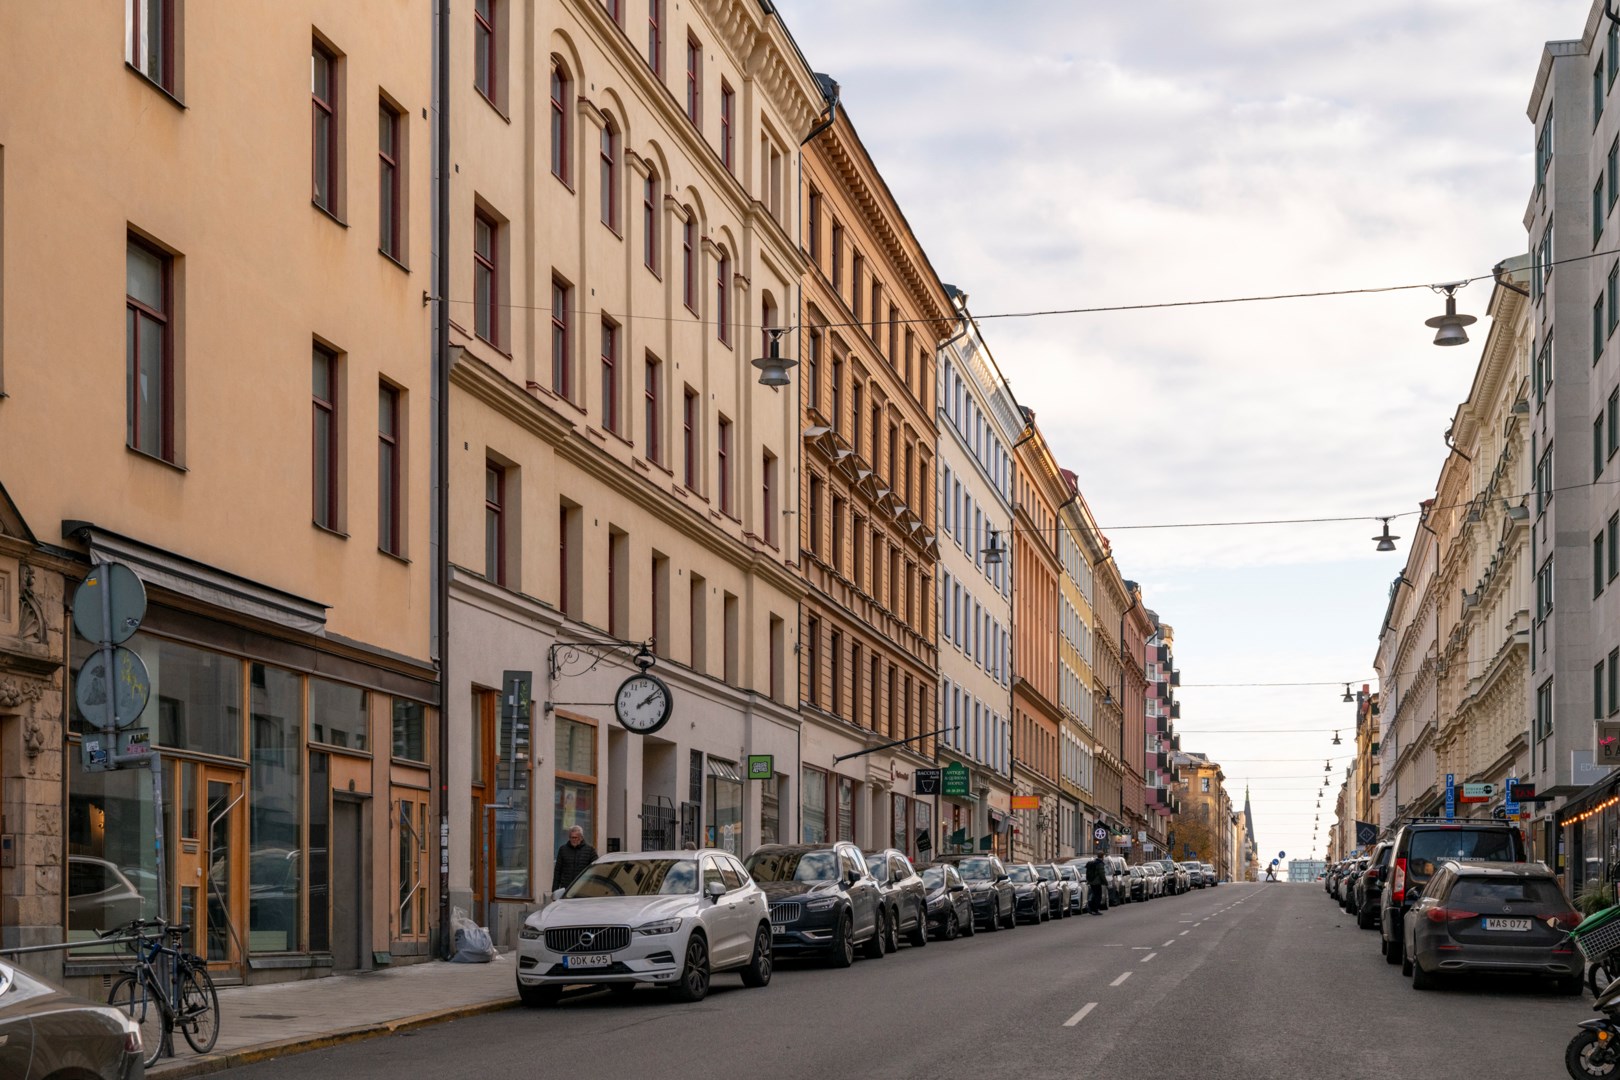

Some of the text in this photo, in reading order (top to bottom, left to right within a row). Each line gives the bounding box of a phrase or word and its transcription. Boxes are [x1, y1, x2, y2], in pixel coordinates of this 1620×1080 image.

[1490, 920, 1508, 928] WAS
[570, 956, 608, 966] ODK 495
